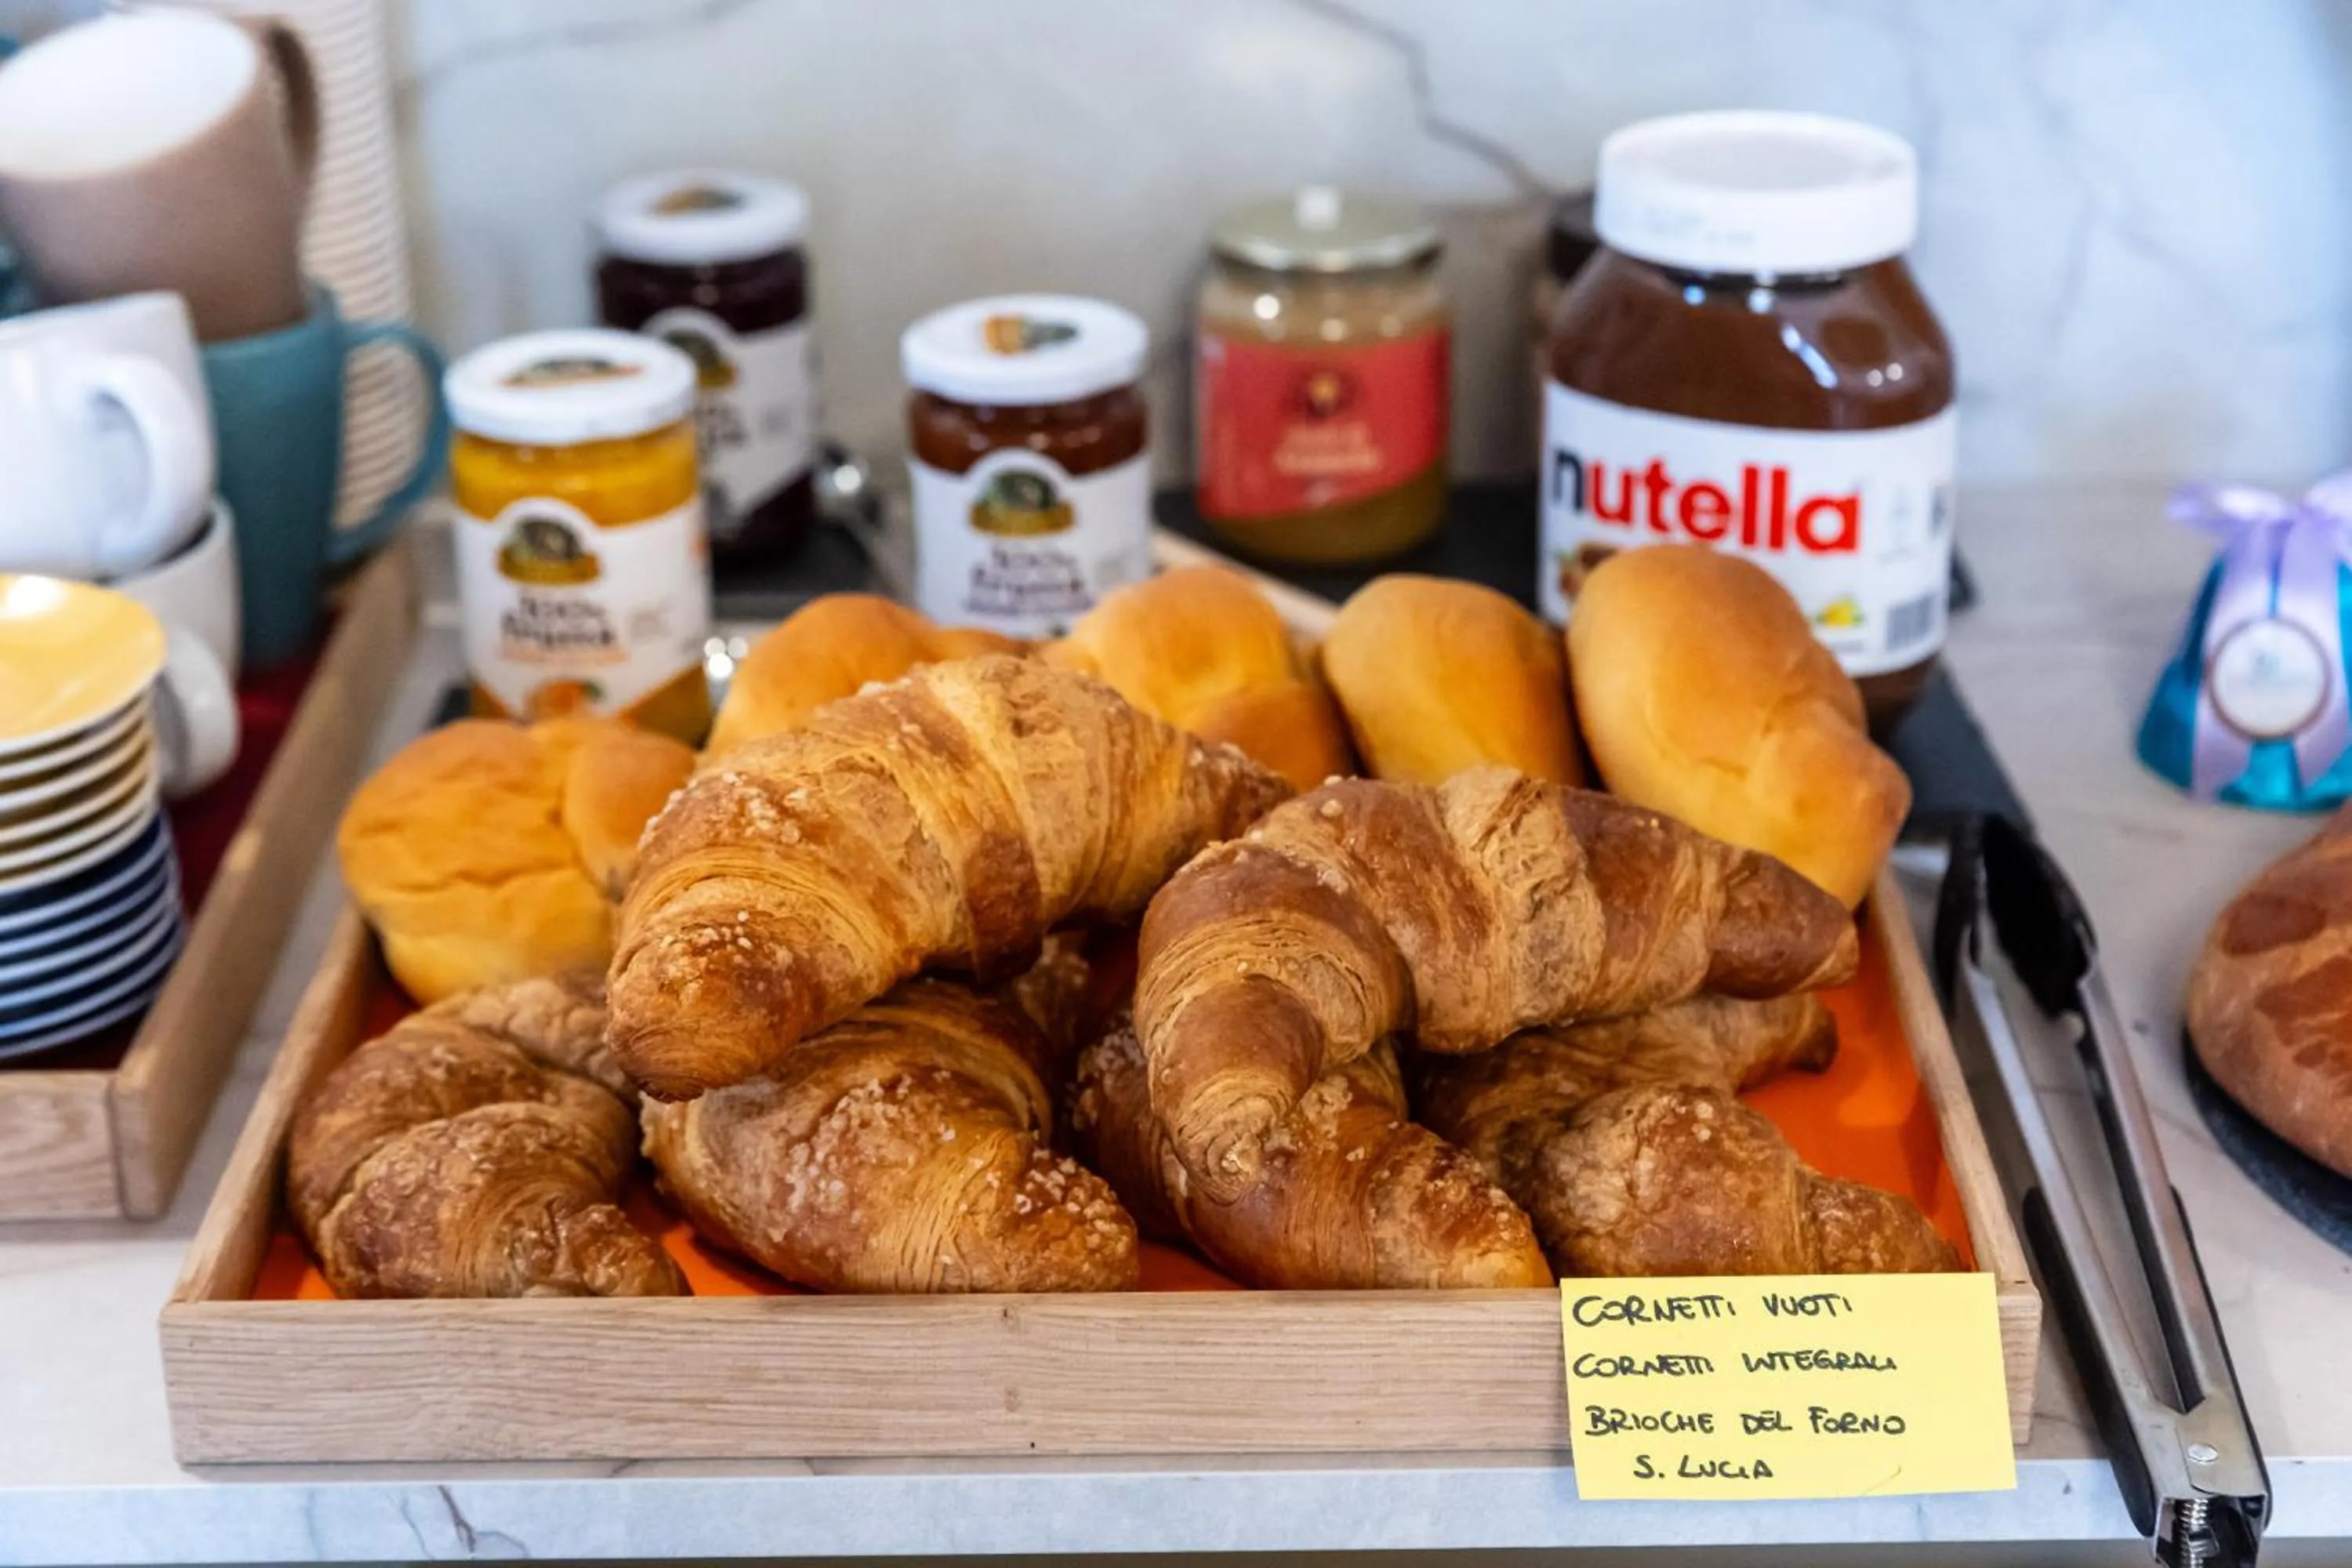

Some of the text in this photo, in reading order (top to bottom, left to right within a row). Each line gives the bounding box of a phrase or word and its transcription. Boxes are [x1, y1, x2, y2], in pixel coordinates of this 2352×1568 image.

[1552, 448, 1861, 556] nutella
[1572, 1293, 1853, 1327] CORNETTI VUOTI
[1572, 1348, 1897, 1378] CORNETTI INTEGRALI
[1584, 1406, 1907, 1436] BRIOCHE DEL FORNO
[1633, 1454, 1773, 1479] S. LUCIA
